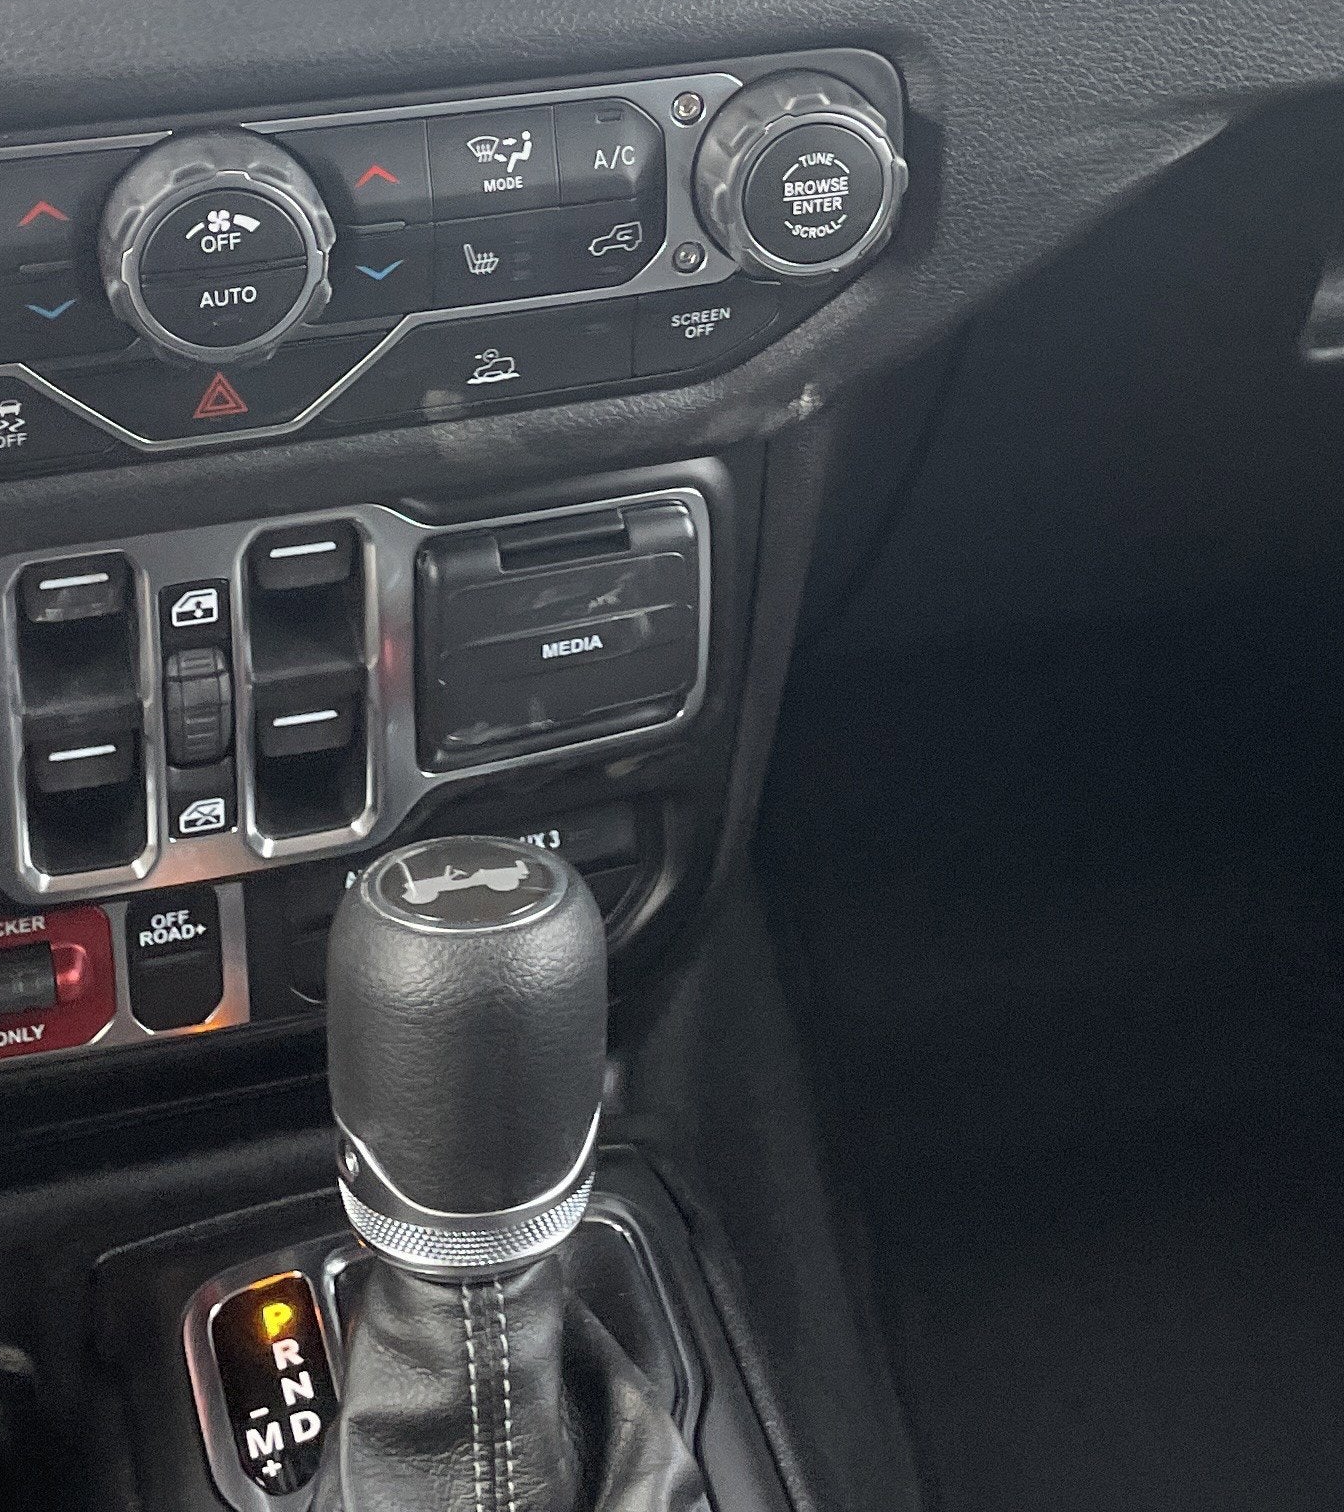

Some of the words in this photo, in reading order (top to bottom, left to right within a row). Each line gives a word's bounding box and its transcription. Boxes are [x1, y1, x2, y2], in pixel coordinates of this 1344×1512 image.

[592, 142, 637, 170] A/C
[798, 152, 835, 167] TUNE
[483, 175, 523, 193] MODE
[784, 175, 849, 197] BROWSE
[792, 196, 843, 215] ENTER
[791, 220, 843, 239] SCROLL
[200, 231, 242, 254] OFF
[199, 285, 258, 309] AUTO
[670, 307, 731, 327] SCREEN
[684, 323, 715, 339] OFF
[541, 634, 604, 660] MEDIA
[548, 829, 561, 849] 3
[150, 909, 191, 929] OFF
[139, 924, 208, 948] ROAD+
[262, 1302, 293, 1340] P
[272, 1338, 305, 1370] R
[280, 1370, 315, 1406] N
[289, 1410, 321, 1443] D
[245, 1421, 285, 1459] M
